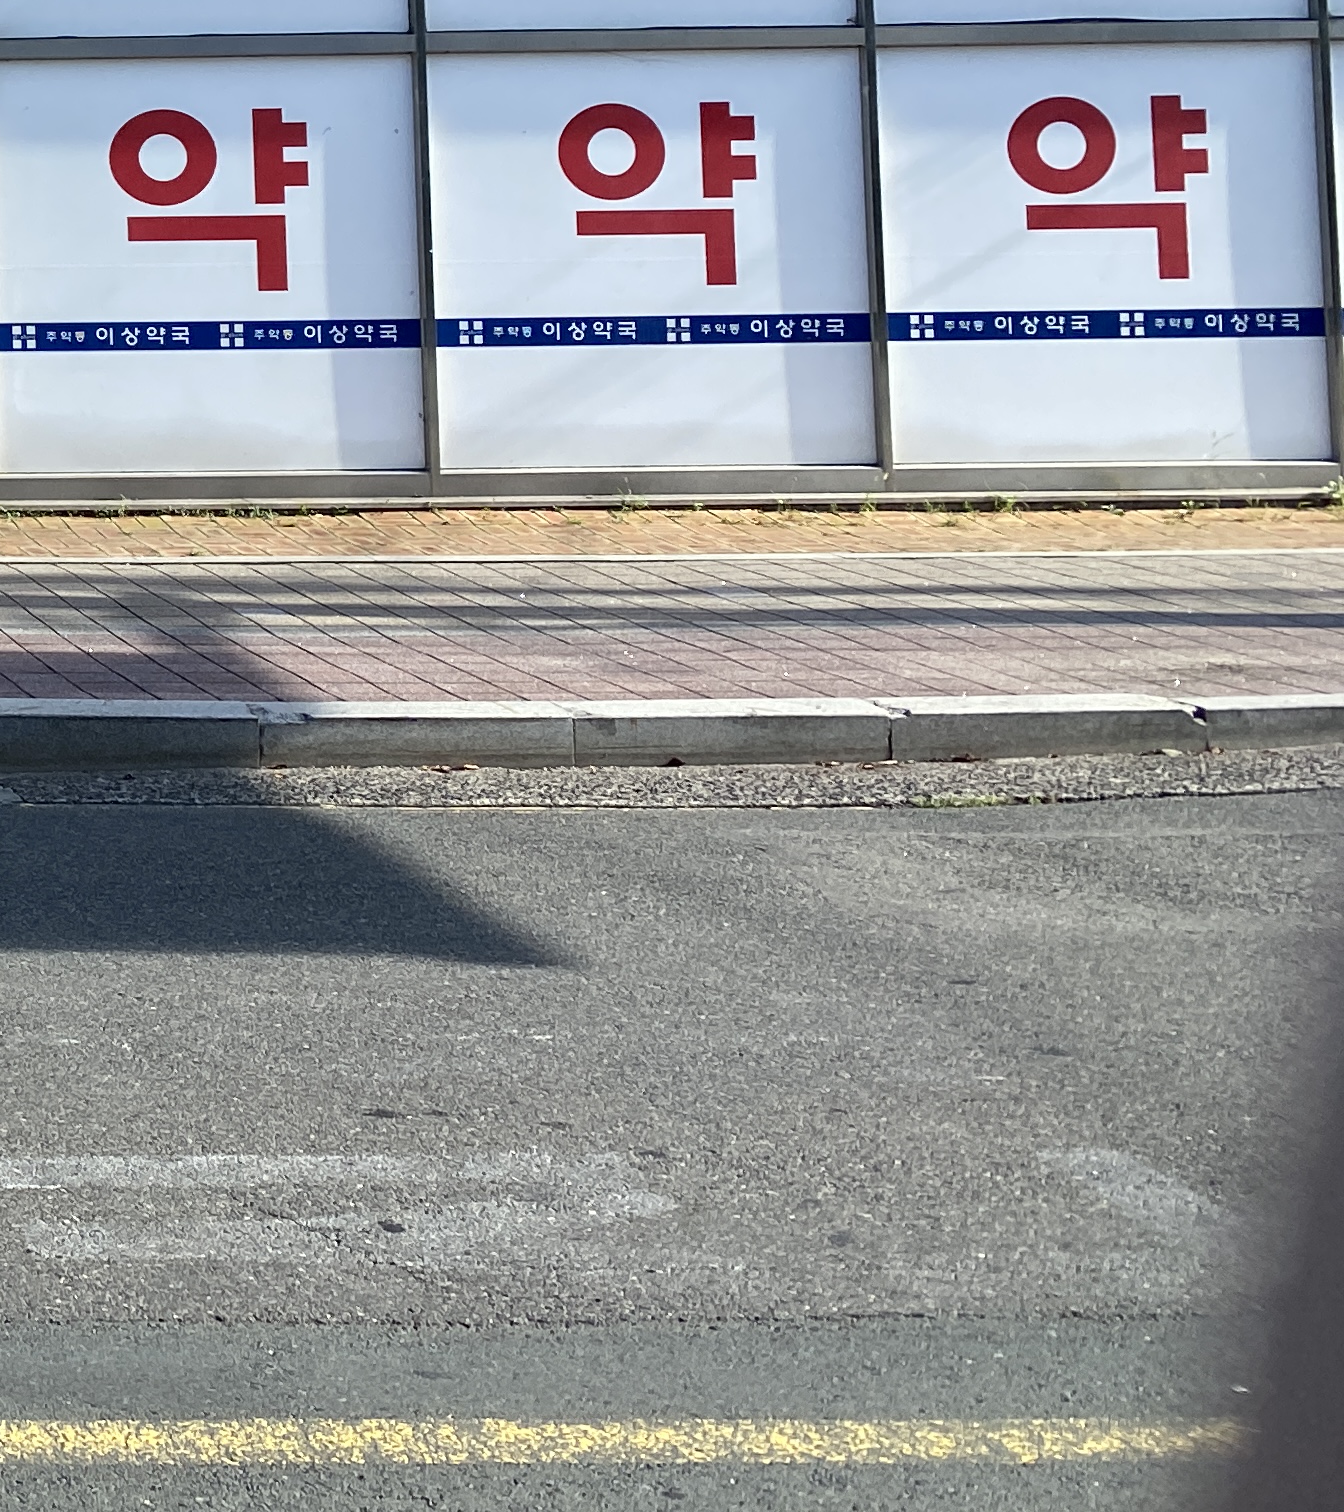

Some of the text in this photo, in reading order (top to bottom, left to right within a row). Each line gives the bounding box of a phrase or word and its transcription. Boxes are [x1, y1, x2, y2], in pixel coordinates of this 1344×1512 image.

[558, 101, 757, 285] 약
[1007, 95, 1209, 279] 약
[109, 108, 309, 291] 약
[542, 321, 637, 341] 이상약국
[750, 318, 845, 339] 이상약국
[994, 315, 1090, 335] 이상약국
[1204, 312, 1300, 333] 이상약국
[95, 326, 190, 346] 이상약국
[303, 324, 398, 344] 이상약국
